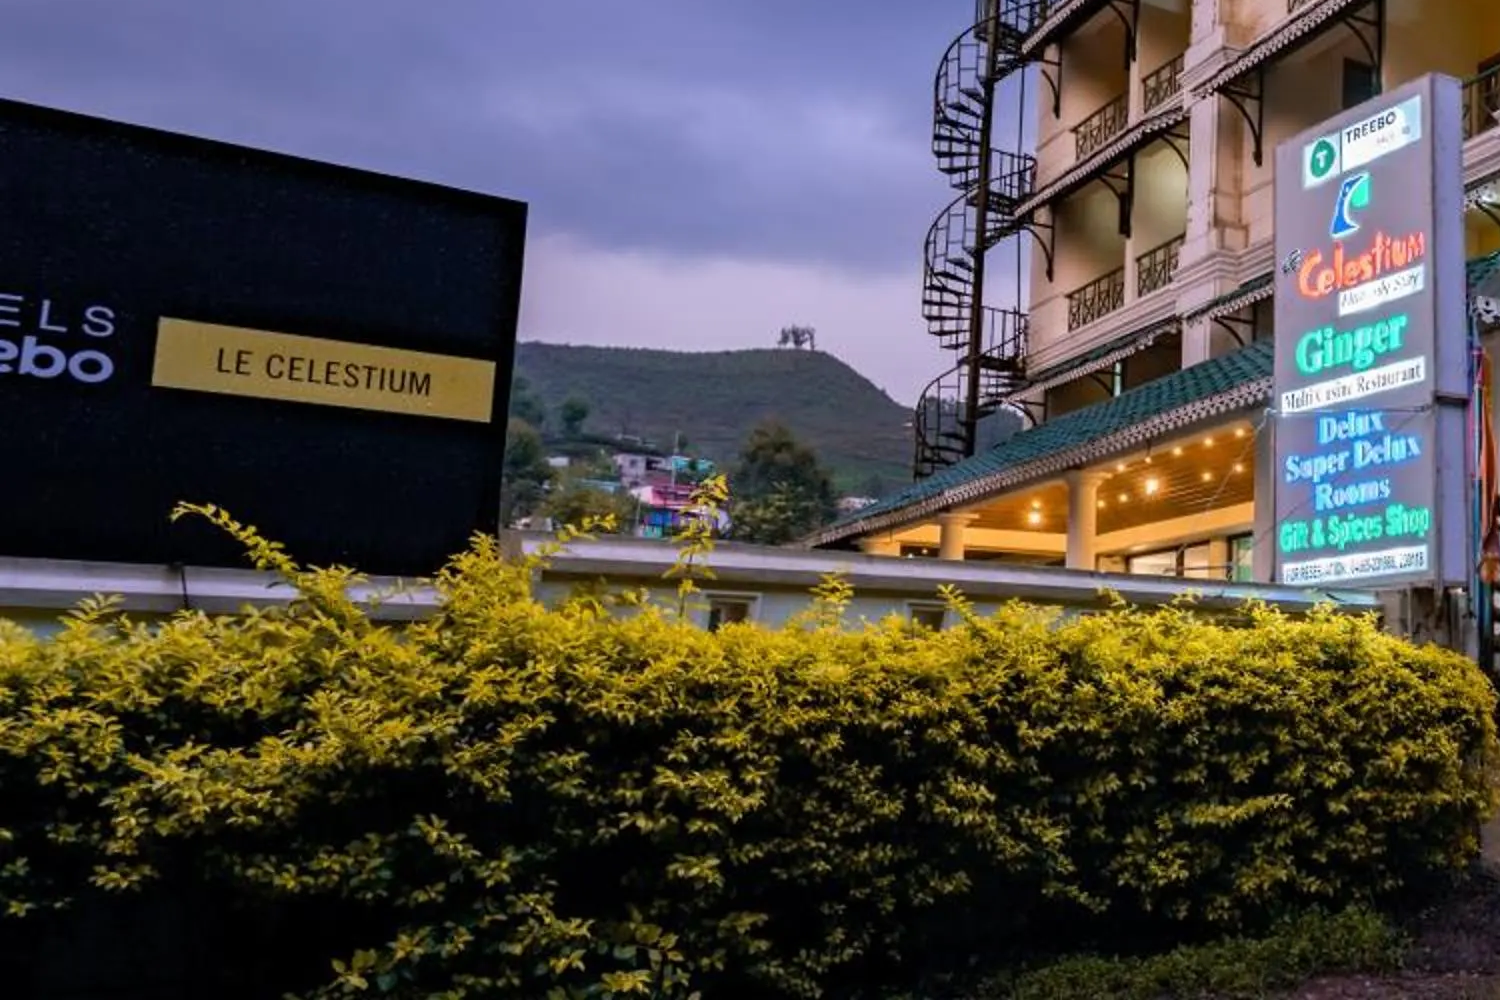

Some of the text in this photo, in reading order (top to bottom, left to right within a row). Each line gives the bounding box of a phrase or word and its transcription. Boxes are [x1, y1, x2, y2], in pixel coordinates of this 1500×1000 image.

[1344, 110, 1397, 145] TREEBO
[1298, 232, 1425, 298] Celestium
[1295, 315, 1407, 374] Ginger
[216, 347, 432, 397] LE CELESTIUM
[1357, 365, 1422, 393] Restaurant
[1318, 410, 1384, 445] Delux
[1284, 434, 1422, 483] Super Delux
[1314, 479, 1391, 511] Rooms
[1327, 512, 1383, 551] Spices
[1385, 503, 1430, 538] Shop
